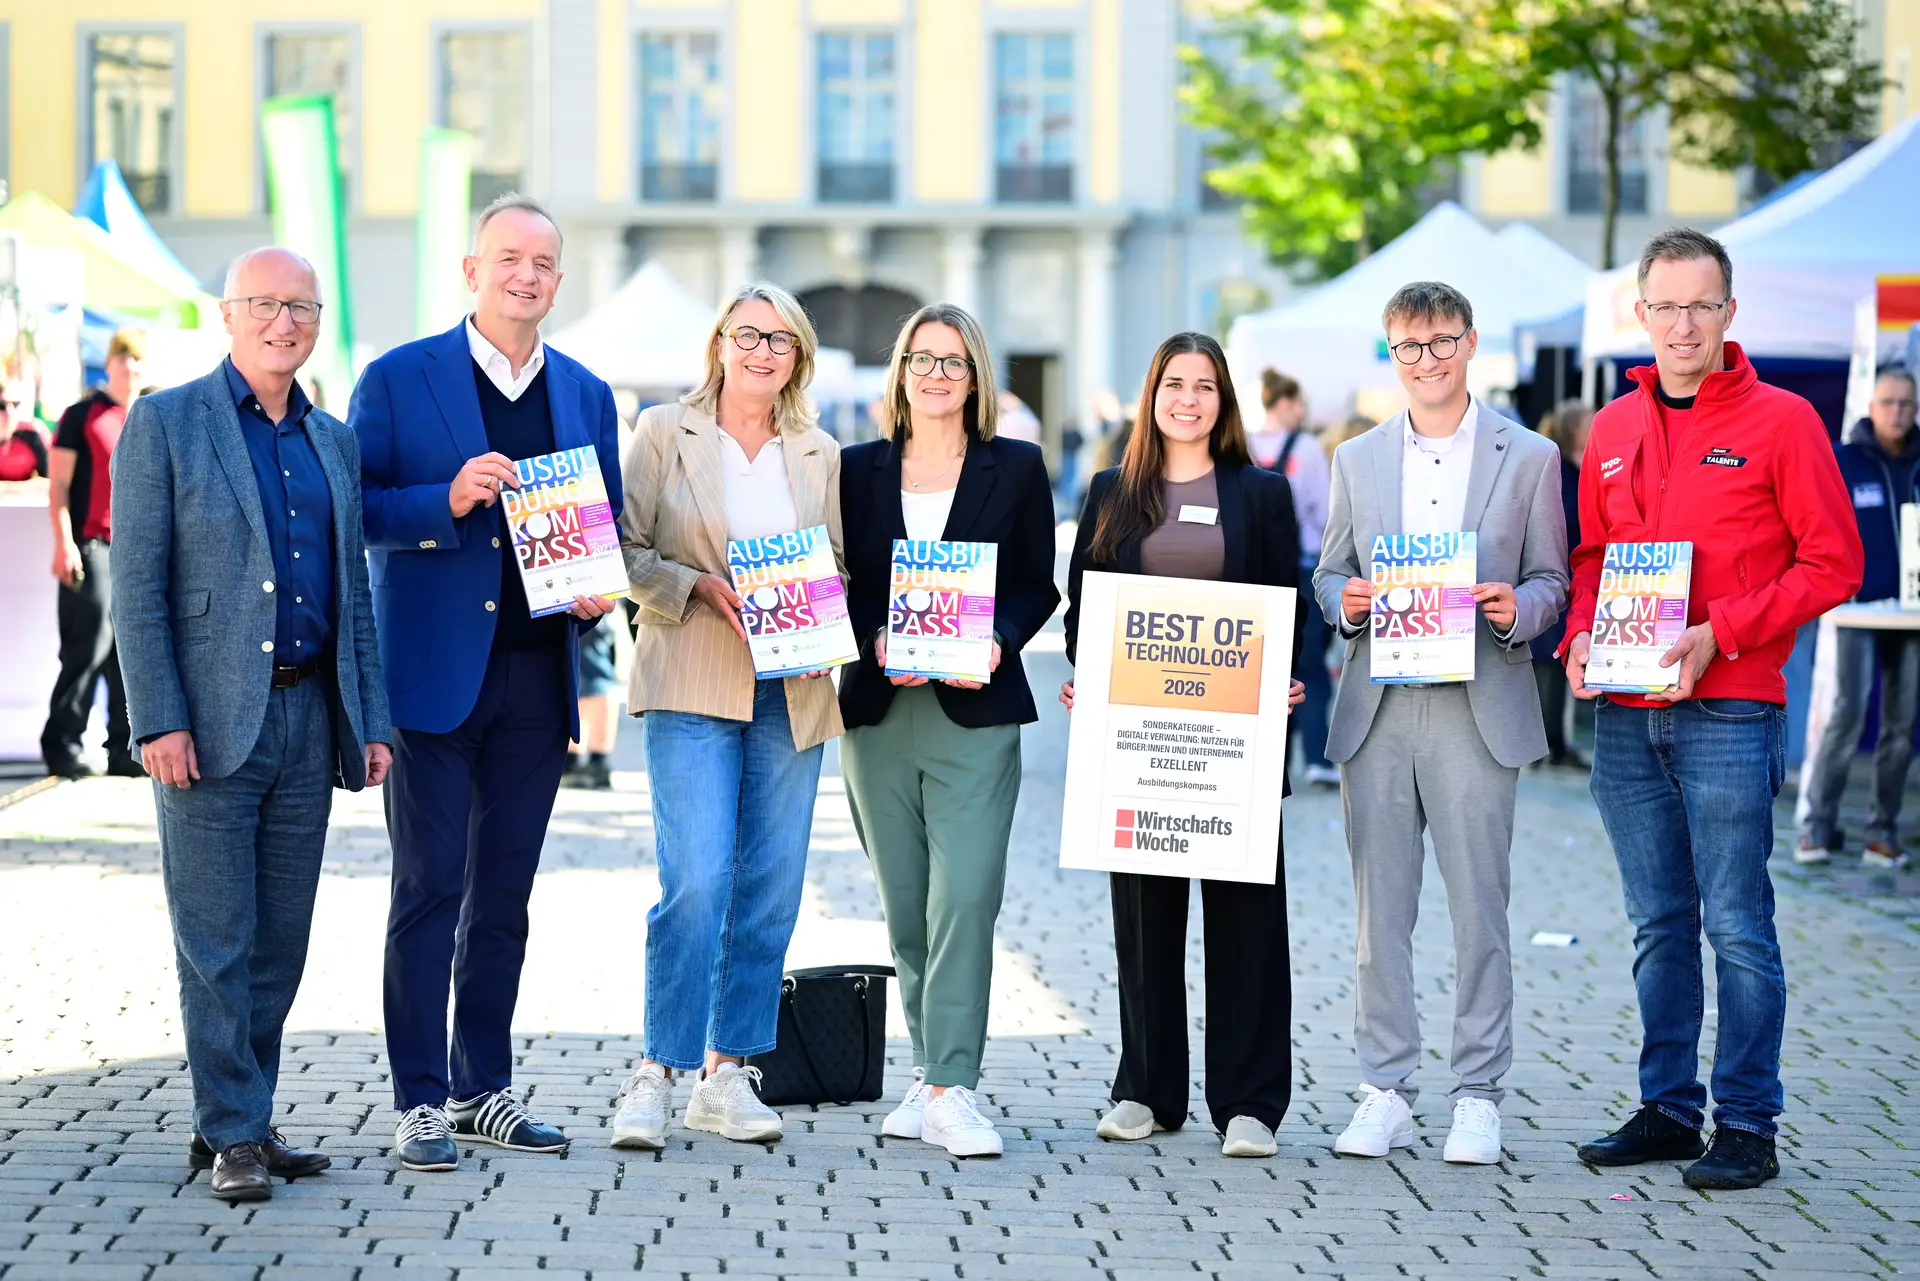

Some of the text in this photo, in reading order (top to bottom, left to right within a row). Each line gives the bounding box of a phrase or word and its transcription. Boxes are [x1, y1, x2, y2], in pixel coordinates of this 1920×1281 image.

[500, 447, 591, 490] USBIL
[1706, 456, 1739, 466] TALENTE
[509, 505, 580, 544] KOM
[515, 531, 587, 569] PASS
[727, 529, 822, 564] AUSBIL
[892, 539, 989, 566] AUSBIL
[1371, 531, 1470, 560] AUSBIL
[1603, 542, 1686, 568] AUSBIL
[730, 553, 822, 588] DUNG
[891, 562, 986, 588] DUNG
[736, 580, 808, 613] KOM
[889, 587, 958, 614] KOM
[1371, 585, 1439, 613] KOM
[1594, 594, 1657, 620] KOM
[741, 604, 815, 636] PASS
[888, 610, 959, 637] PASS
[1125, 610, 1254, 647] BEST OF
[1371, 611, 1441, 638] PASS
[1591, 621, 1655, 647] PASS
[1125, 642, 1250, 668] TECHNOLOGY
[1163, 679, 1206, 697] 2026
[1117, 730, 1244, 747] DIGITALE VERWALTUNG: NUTZEN FÜR
[1142, 720, 1214, 733] SONDERKATEGORIE
[1116, 740, 1244, 758] BÜRGER:INNEN UND UNTERNEHMEN
[1150, 757, 1208, 772] EXZELLENT
[1137, 777, 1217, 791] Ausbildungskompass
[1137, 810, 1233, 836] Wirtschafts
[1135, 831, 1189, 853] Woche
